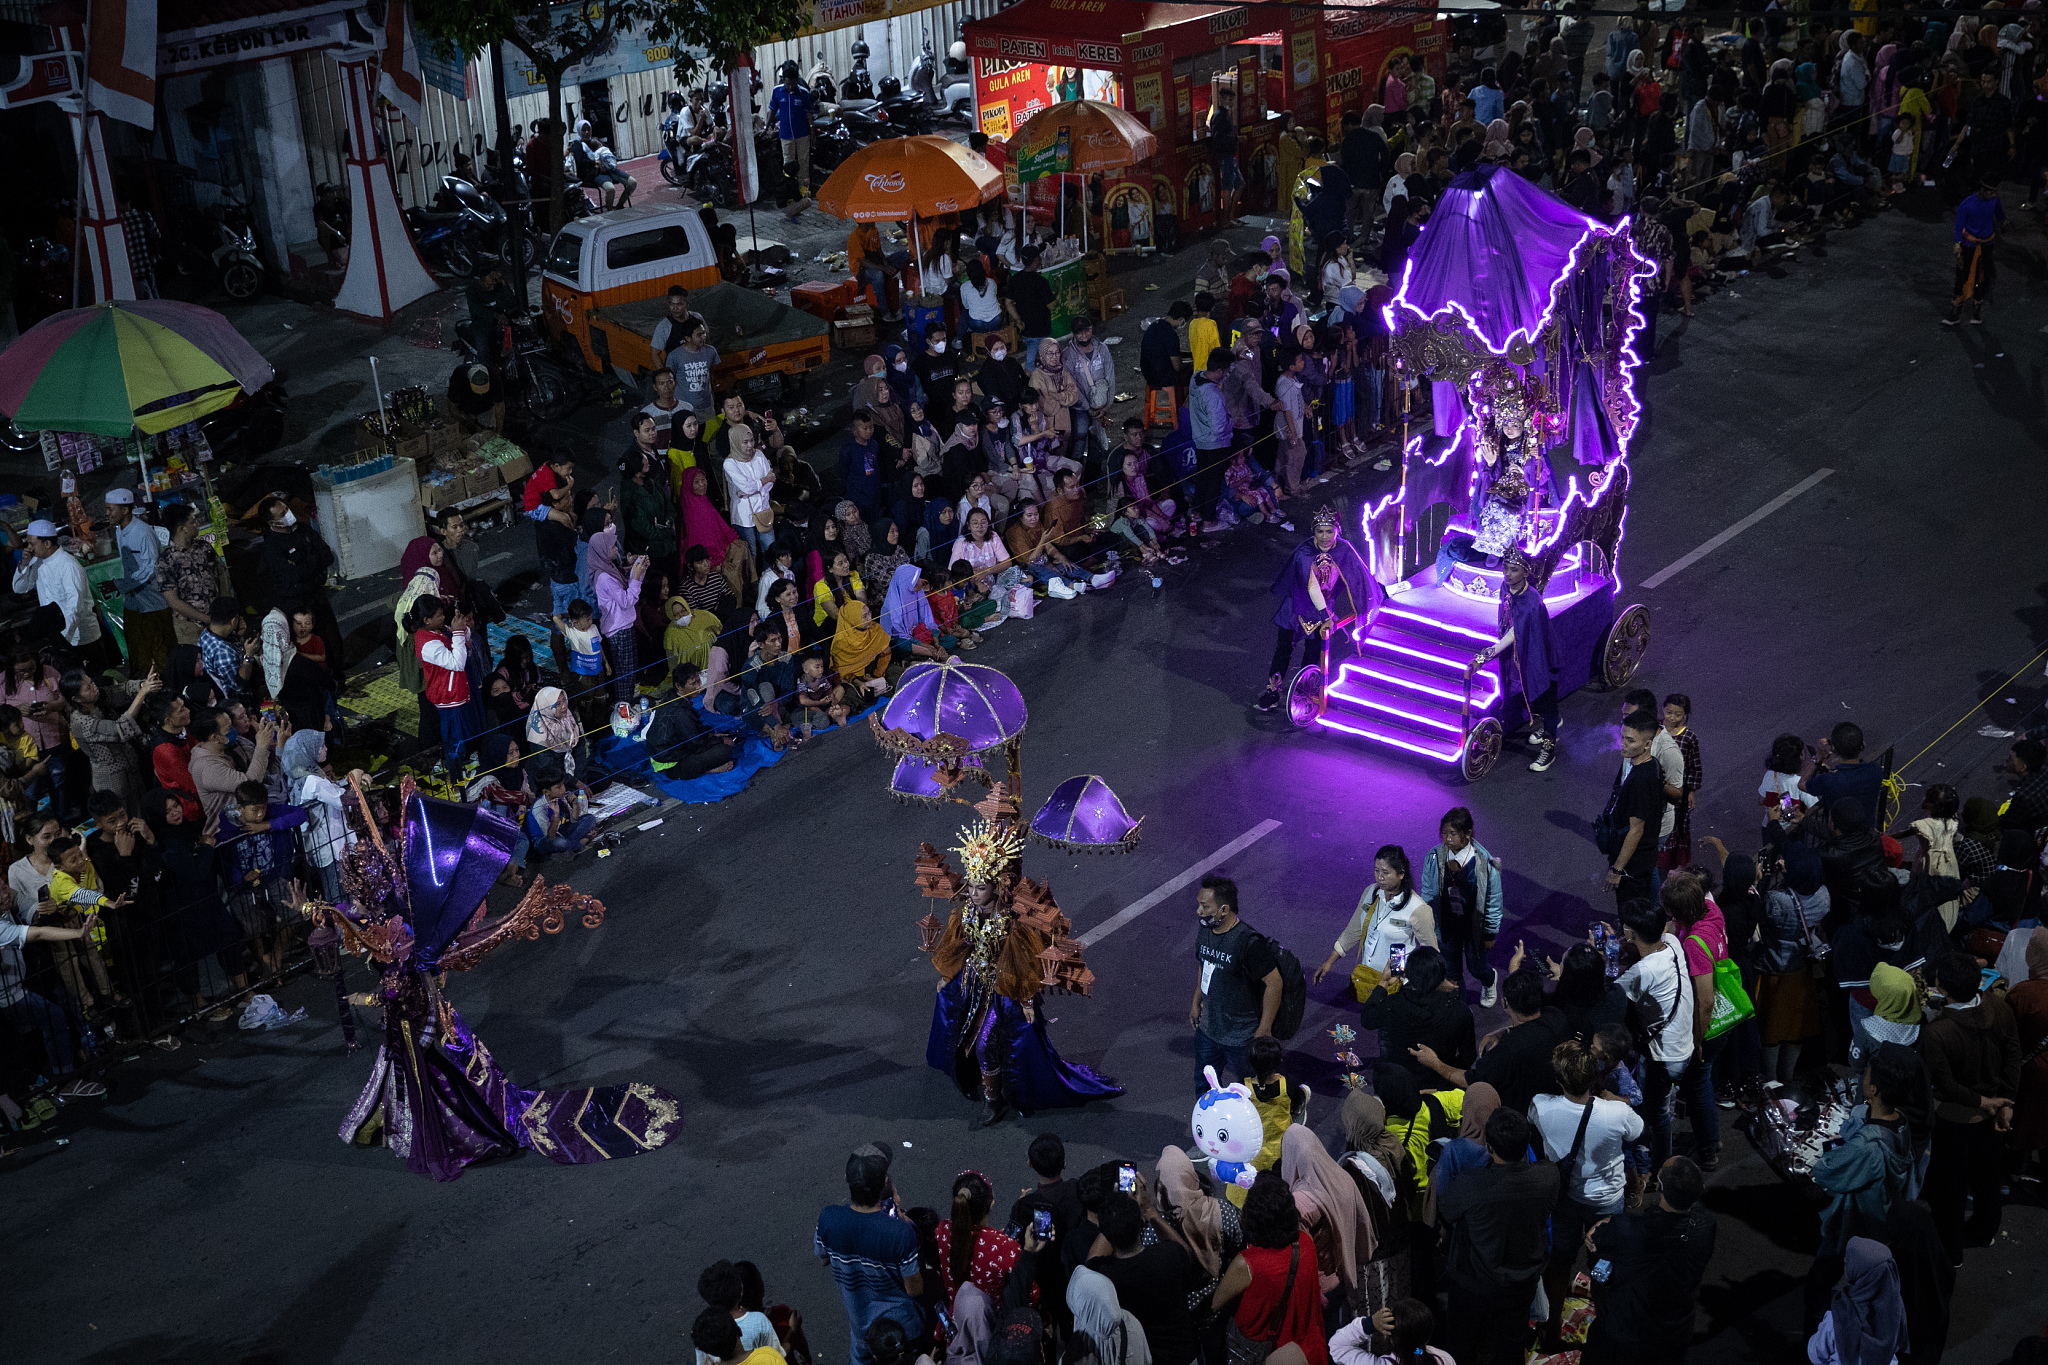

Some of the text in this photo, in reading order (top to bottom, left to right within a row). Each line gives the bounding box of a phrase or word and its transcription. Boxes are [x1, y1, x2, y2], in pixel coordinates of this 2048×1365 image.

[827, 1, 865, 21] TAHUN
[1078, 1, 1106, 12] AREN
[1209, 8, 1248, 34] PIKOPI
[976, 37, 997, 48] lebih
[1001, 38, 1045, 57] PATEN
[1052, 45, 1075, 56] lebih
[1417, 34, 1442, 48] PIKOPI
[1132, 42, 1164, 62] PIKOPI
[989, 69, 1031, 92] GULA AREN
[1135, 78, 1159, 91] PIKOPI
[1326, 66, 1363, 97] PIKOPI
[982, 106, 1006, 121] PIKOPI
[684, 361, 708, 370] EVERY
[685, 367, 709, 377] THING
